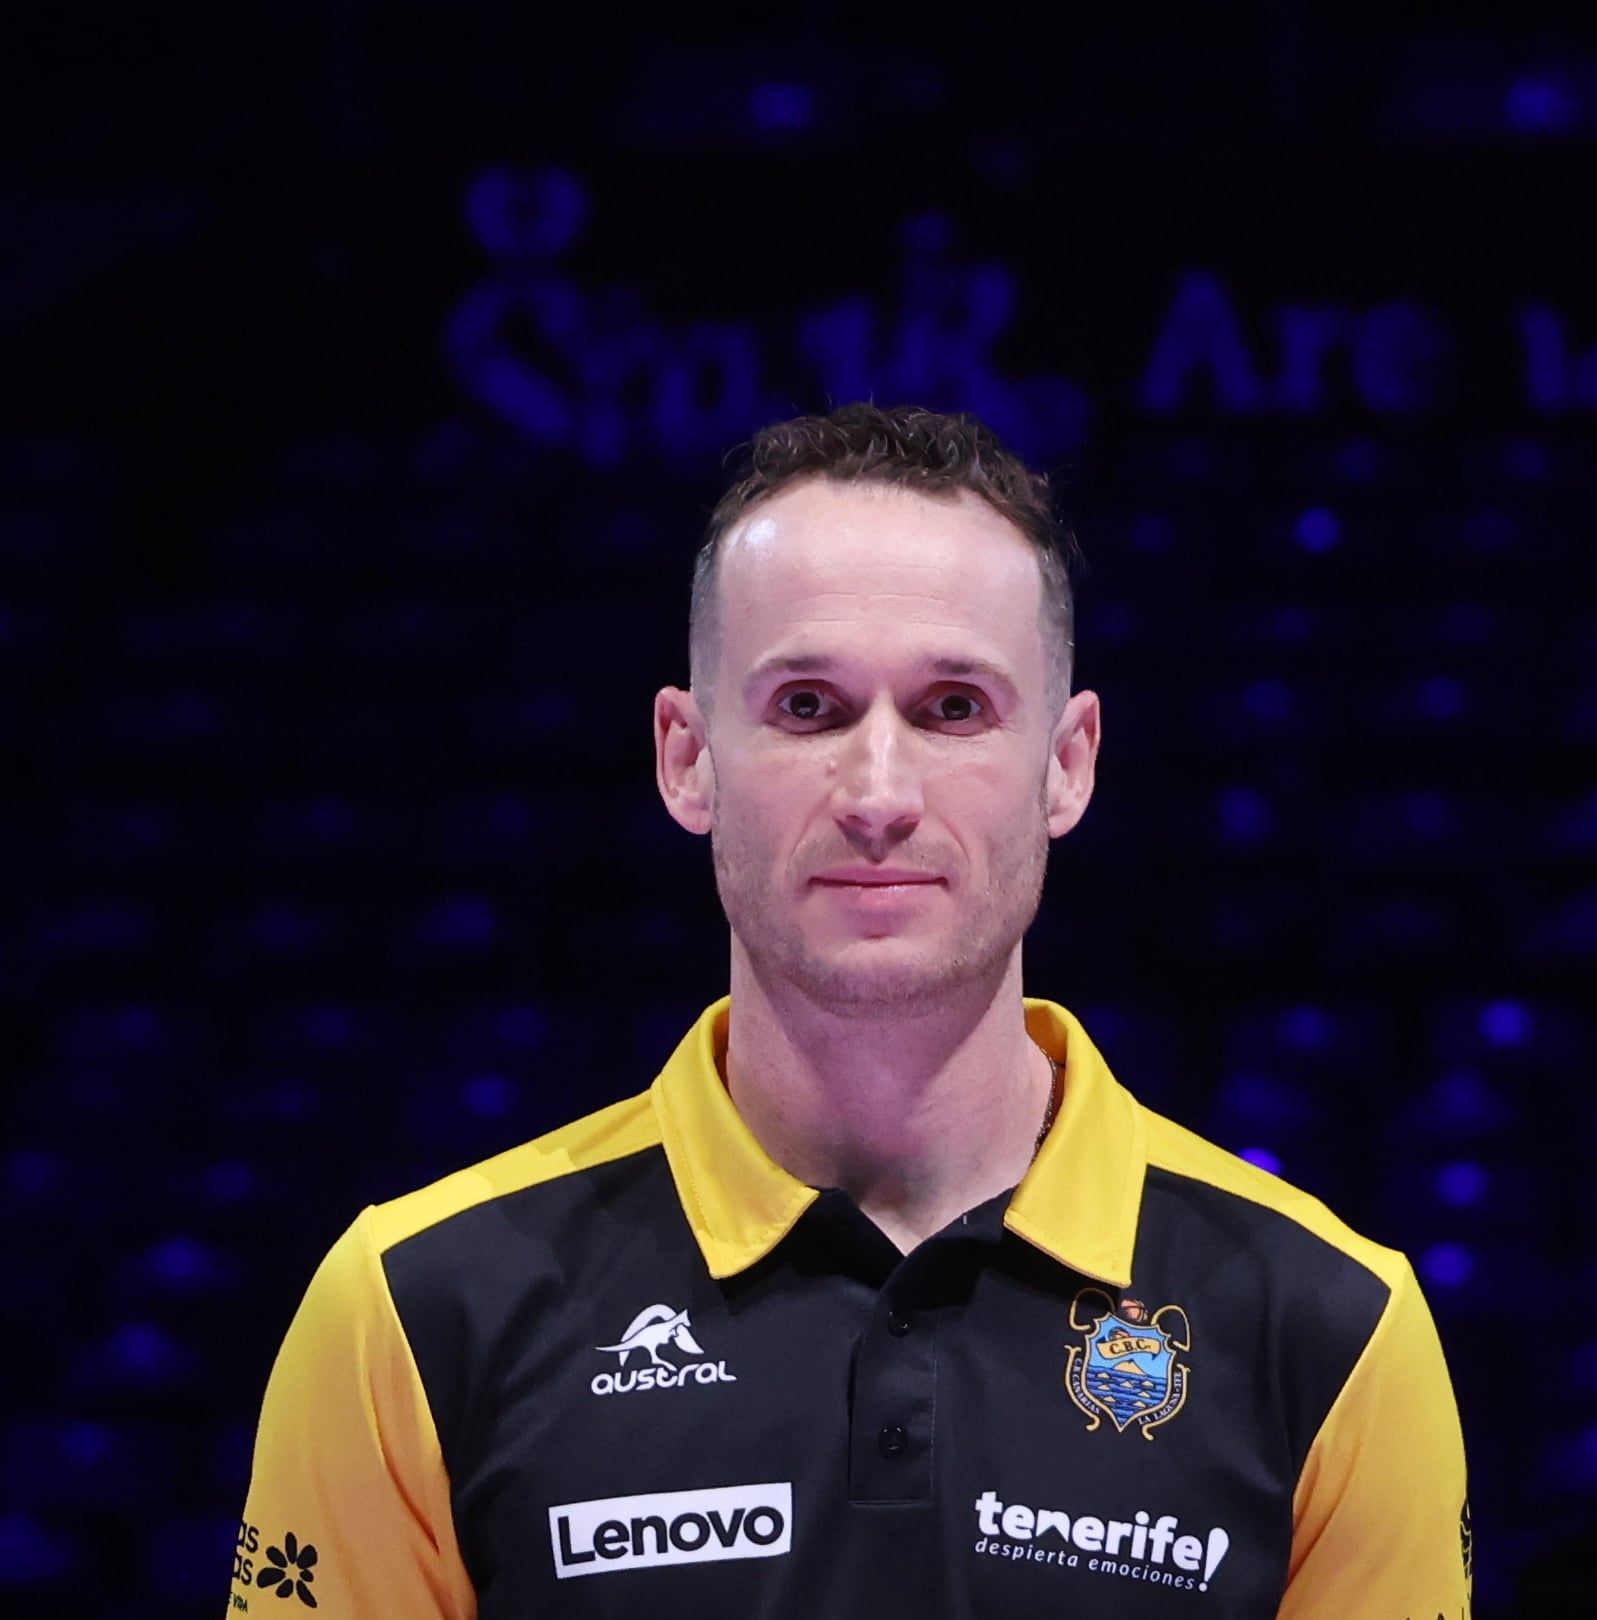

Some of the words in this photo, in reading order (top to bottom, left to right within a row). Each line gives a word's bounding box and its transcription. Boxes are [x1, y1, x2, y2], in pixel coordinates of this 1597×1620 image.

[557, 1505, 785, 1567] Lenovo
[974, 1490, 1230, 1592] tenerife!
[974, 1537, 1080, 1568] despierta
[1088, 1556, 1196, 1590] emociones
